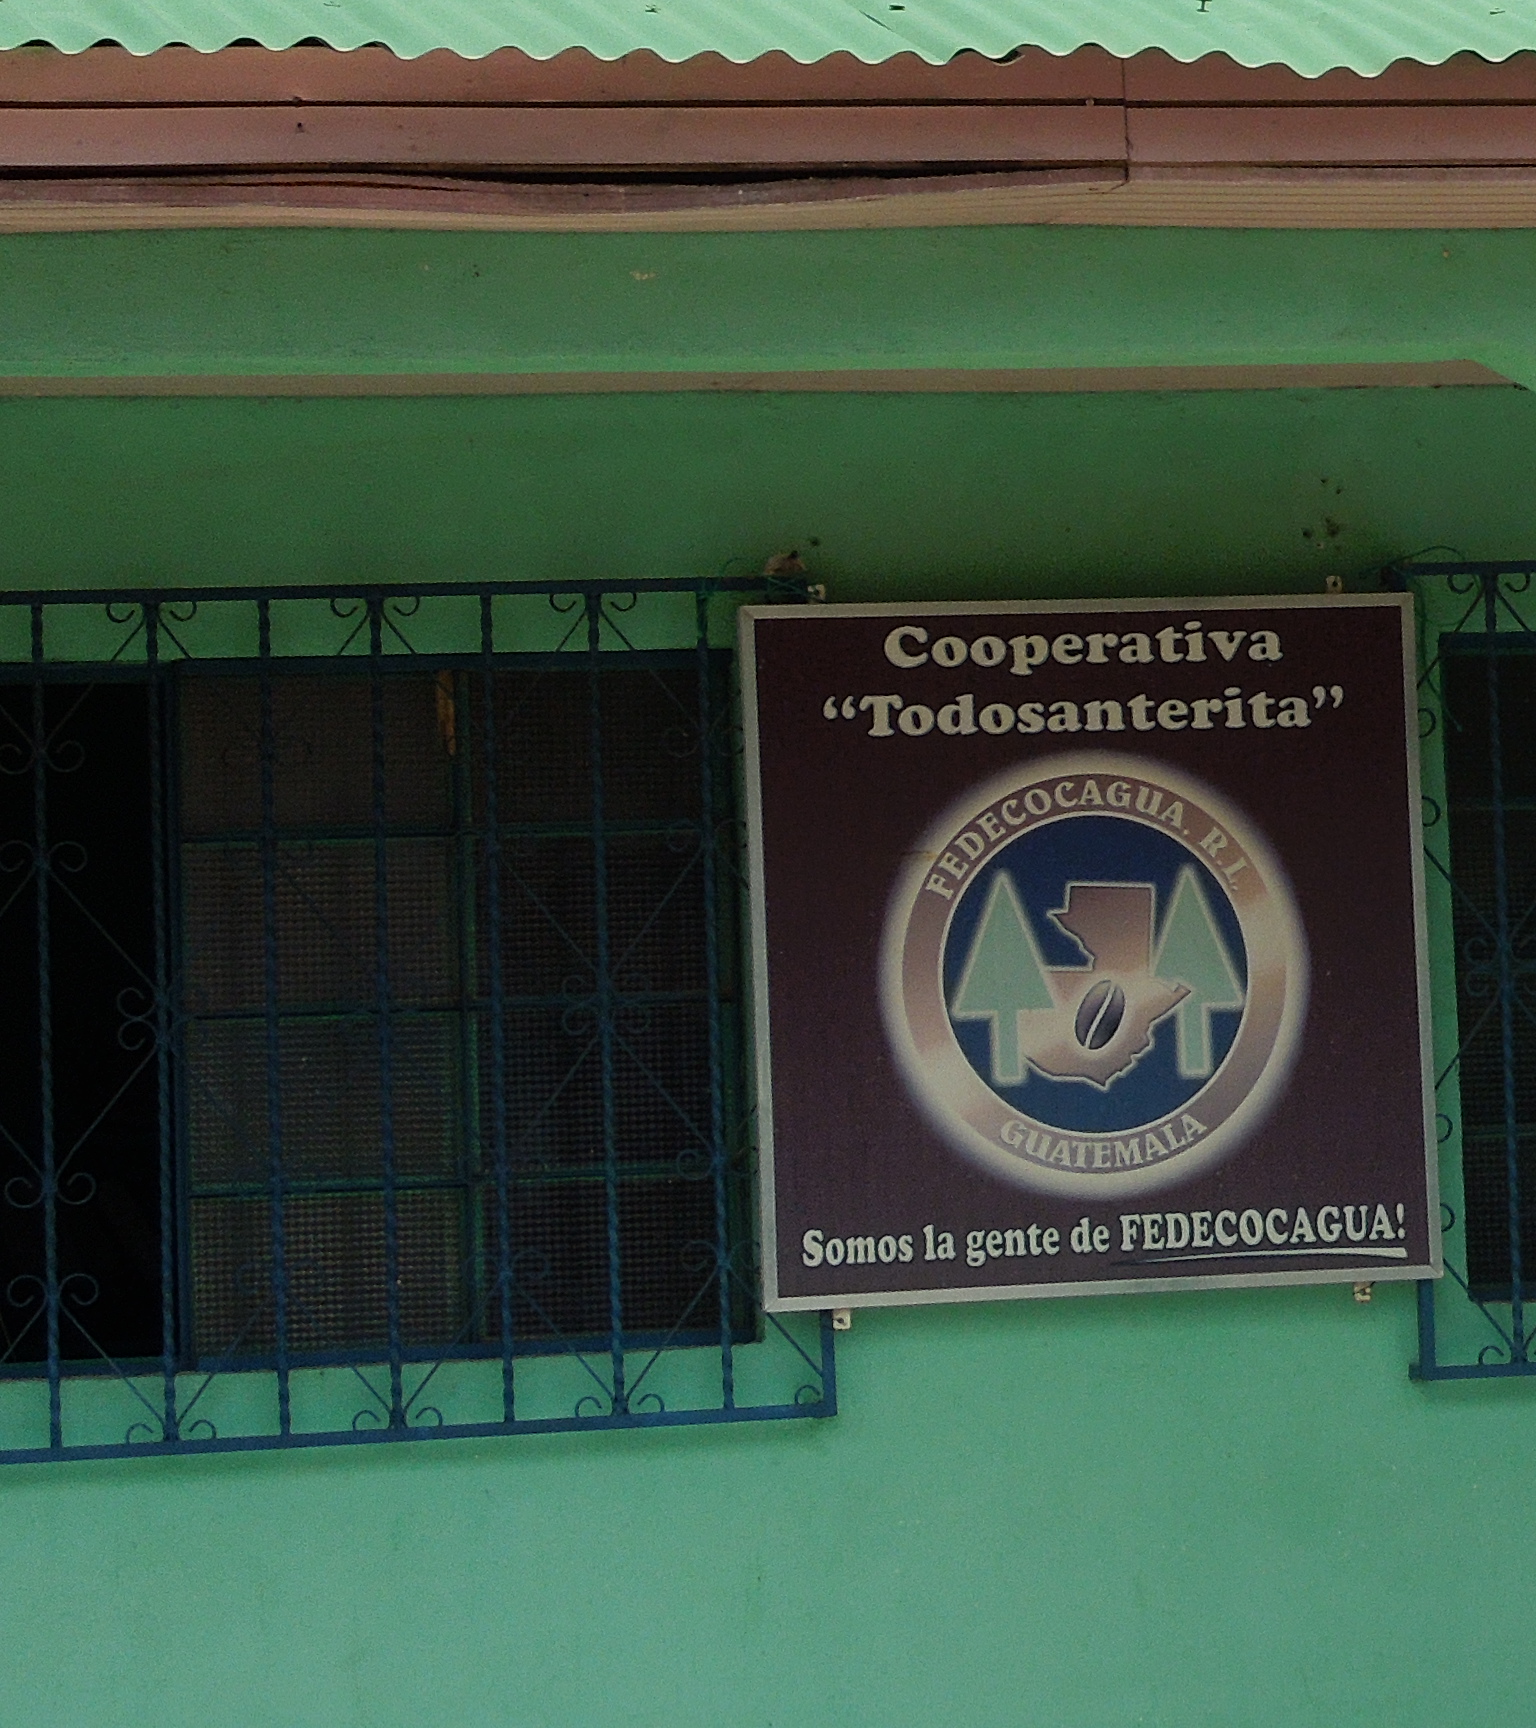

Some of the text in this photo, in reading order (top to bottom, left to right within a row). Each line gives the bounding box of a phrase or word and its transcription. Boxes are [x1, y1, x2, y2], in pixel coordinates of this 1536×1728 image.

[882, 619, 1284, 676] Cooperativa
[999, 1112, 1208, 1169] GUATEMALA
[801, 1202, 1408, 1268] Somos la gente de FEDECOCAGUA!
